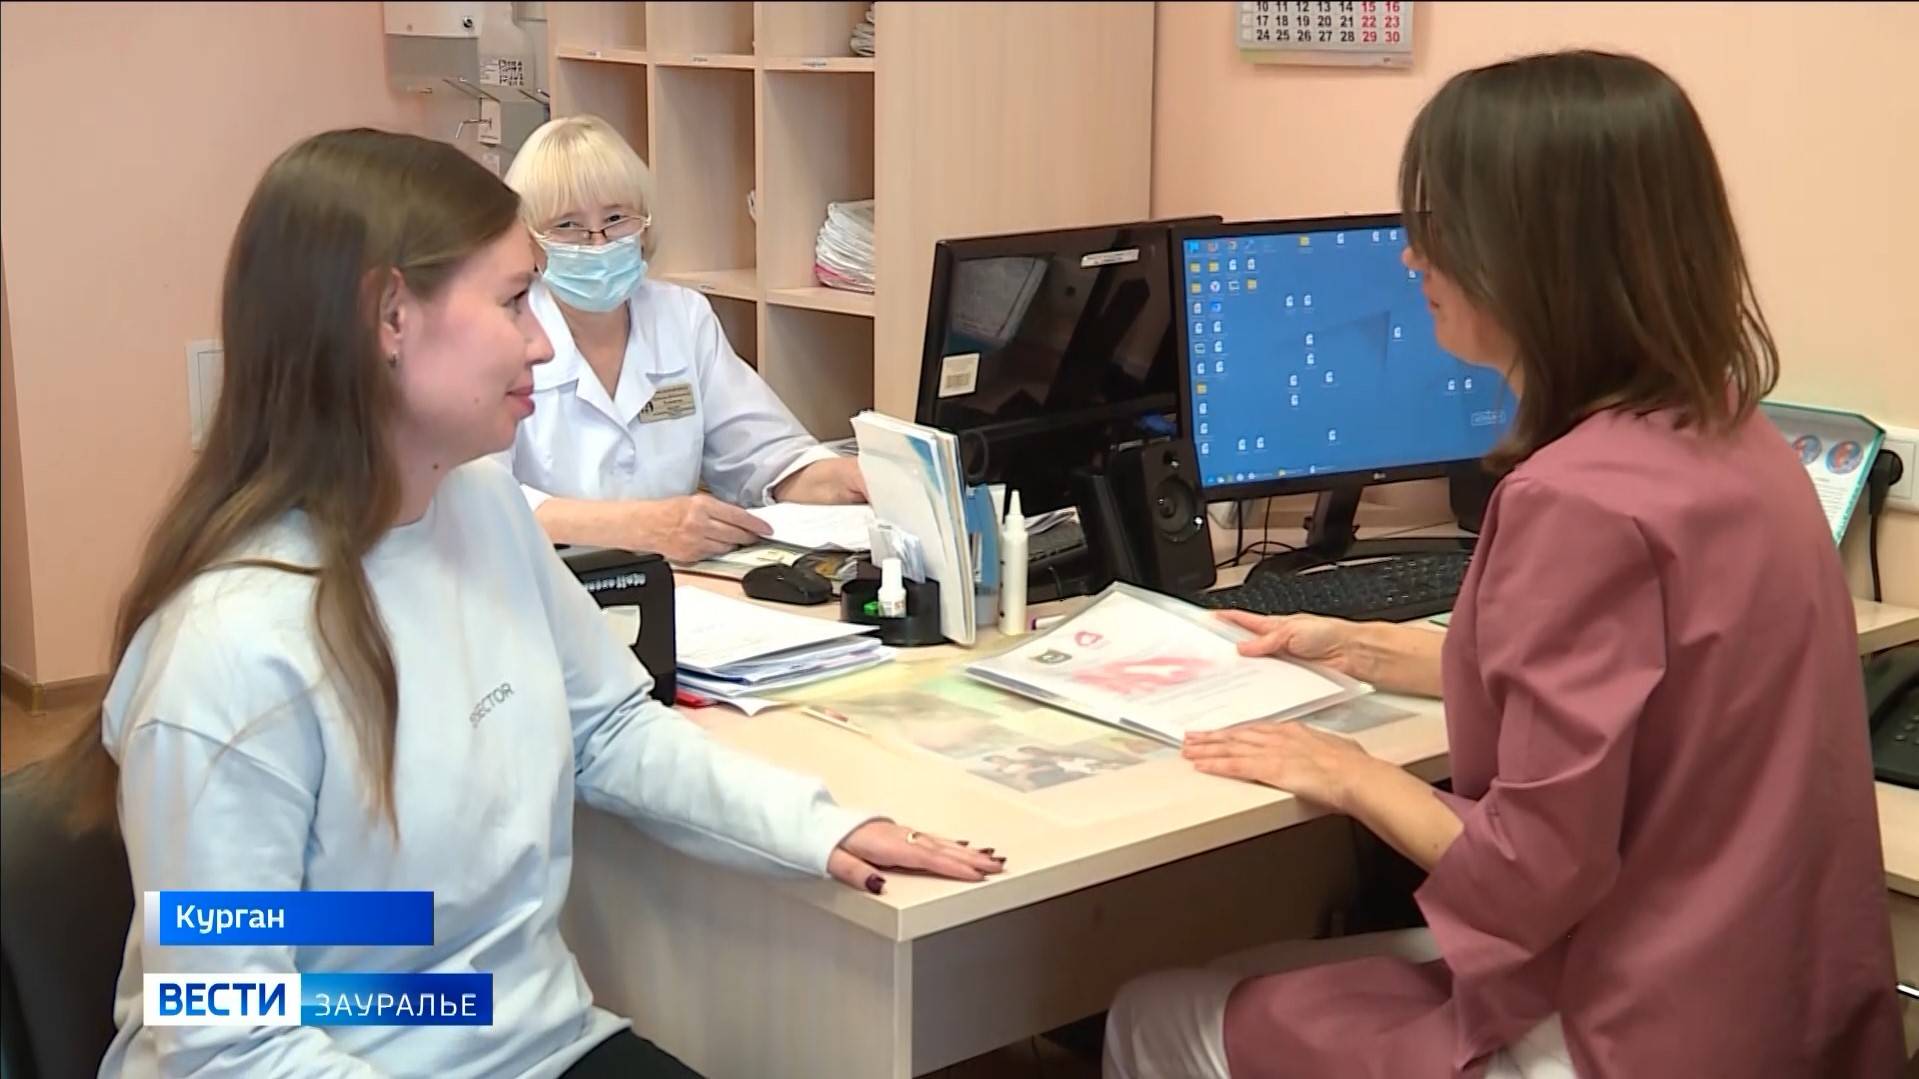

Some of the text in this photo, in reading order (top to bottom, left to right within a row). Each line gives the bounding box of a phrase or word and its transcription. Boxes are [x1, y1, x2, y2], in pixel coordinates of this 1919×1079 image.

[1256, 1, 1400, 12] 10 11 12 13 14 15 16
[1256, 15, 1400, 28] 17 18 19 20 21 22 23
[1256, 29, 1400, 42] 24 25 26 27 28 29 30
